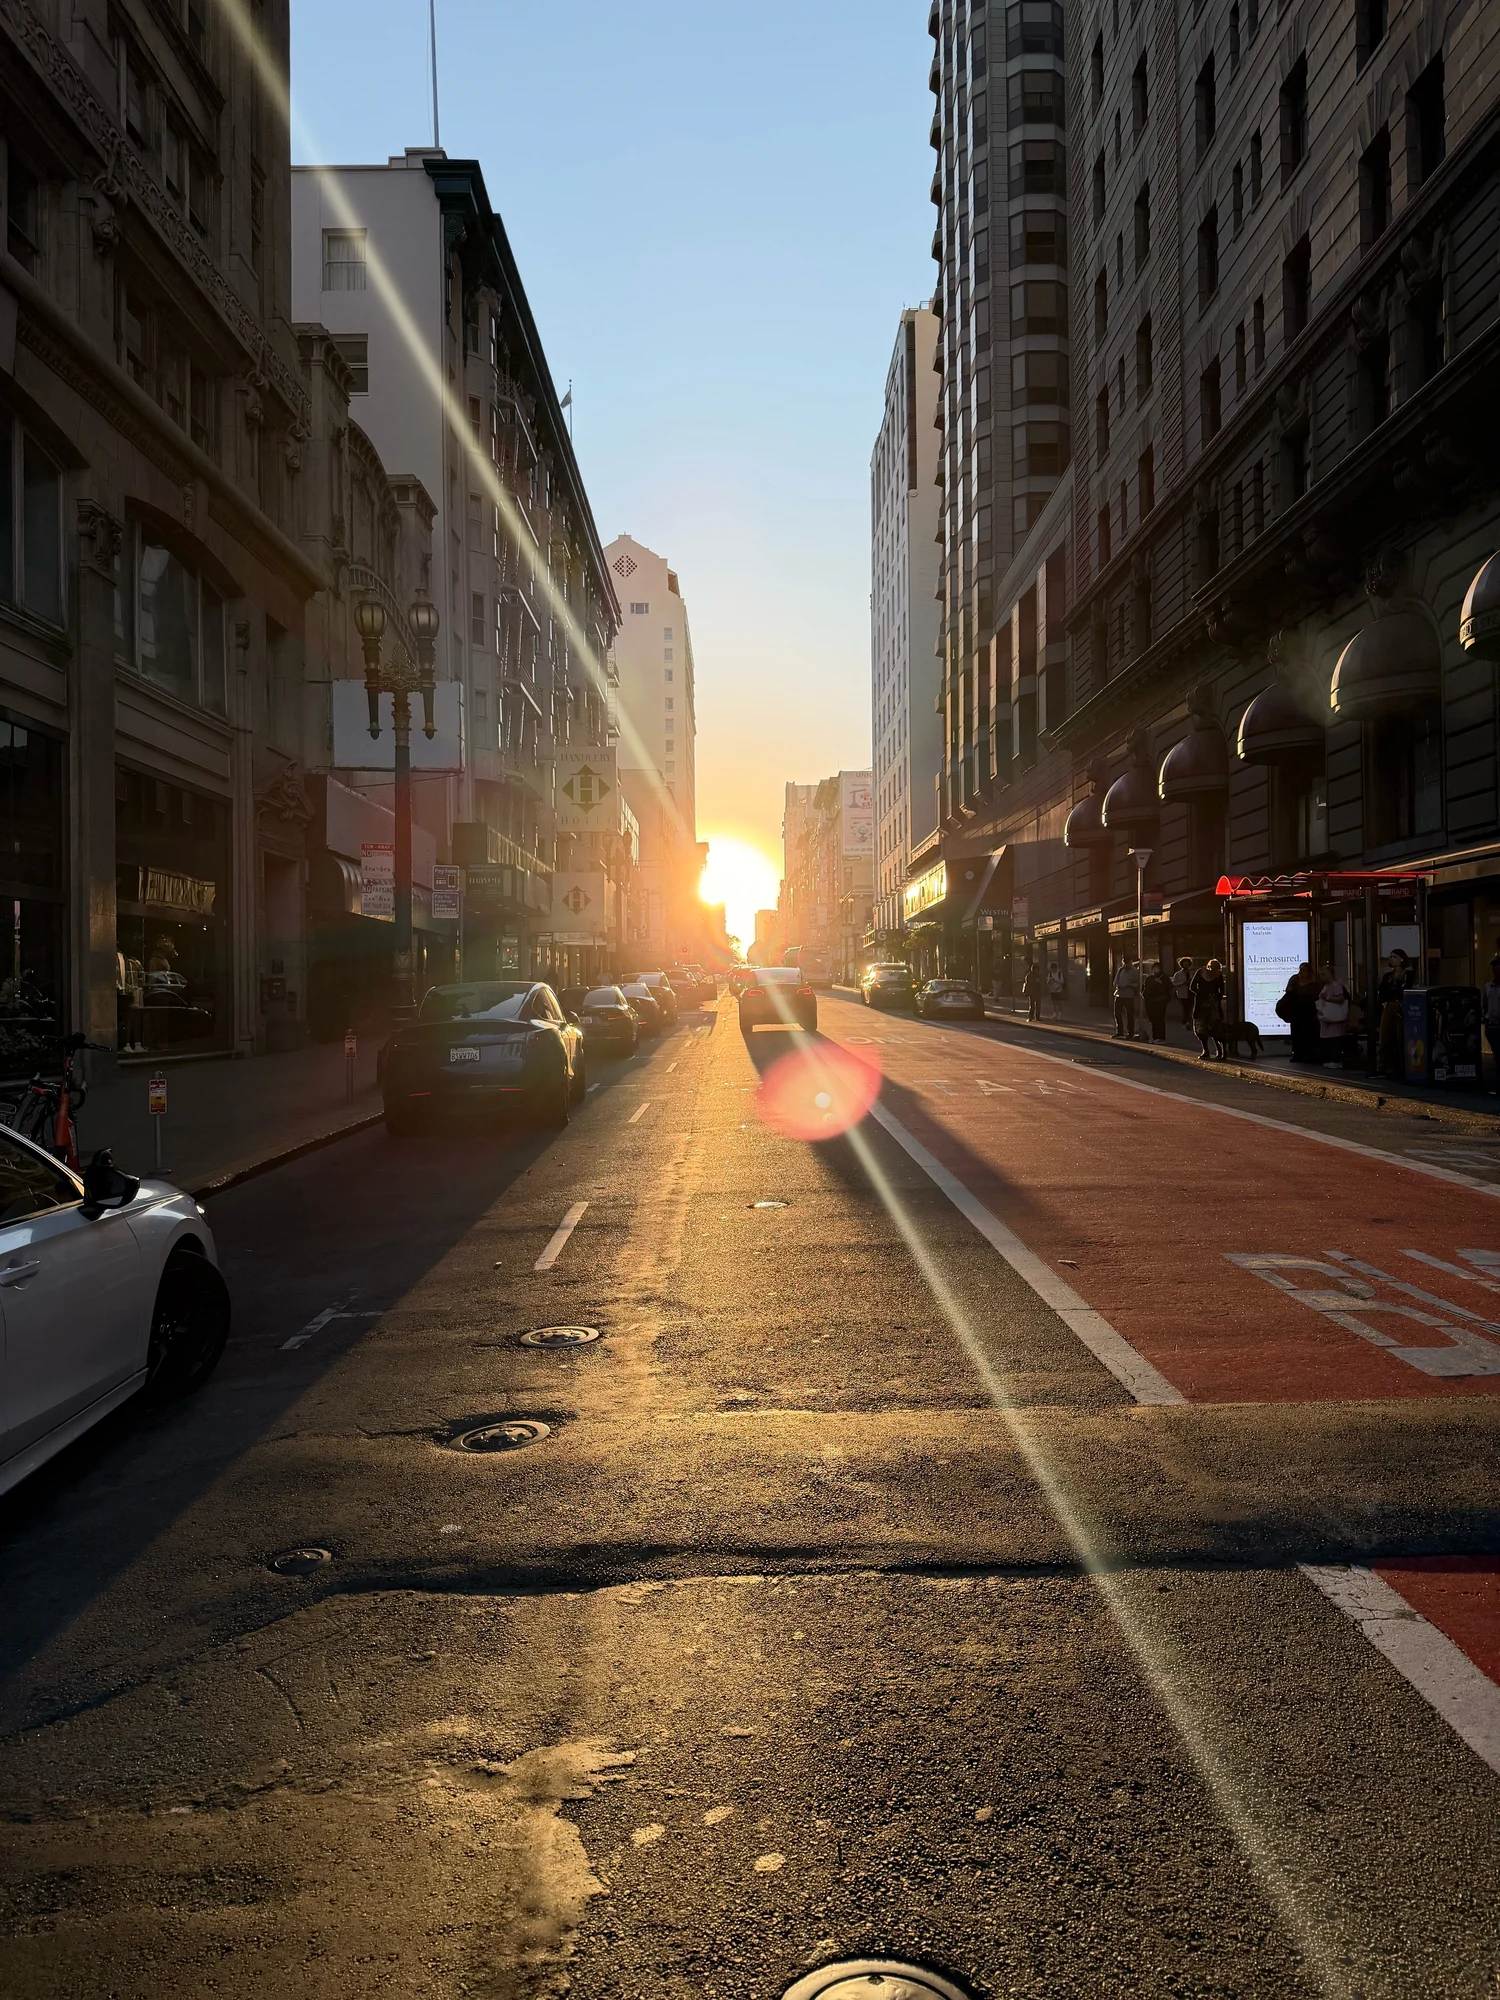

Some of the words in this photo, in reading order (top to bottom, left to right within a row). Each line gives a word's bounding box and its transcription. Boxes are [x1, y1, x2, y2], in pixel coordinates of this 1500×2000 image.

[560, 754, 610, 762] HANDLERY
[561, 816, 614, 825] HOTEL
[877, 931, 887, 941] G
[1260, 954, 1302, 962] measured.
[1220, 1248, 1500, 1377] BU
